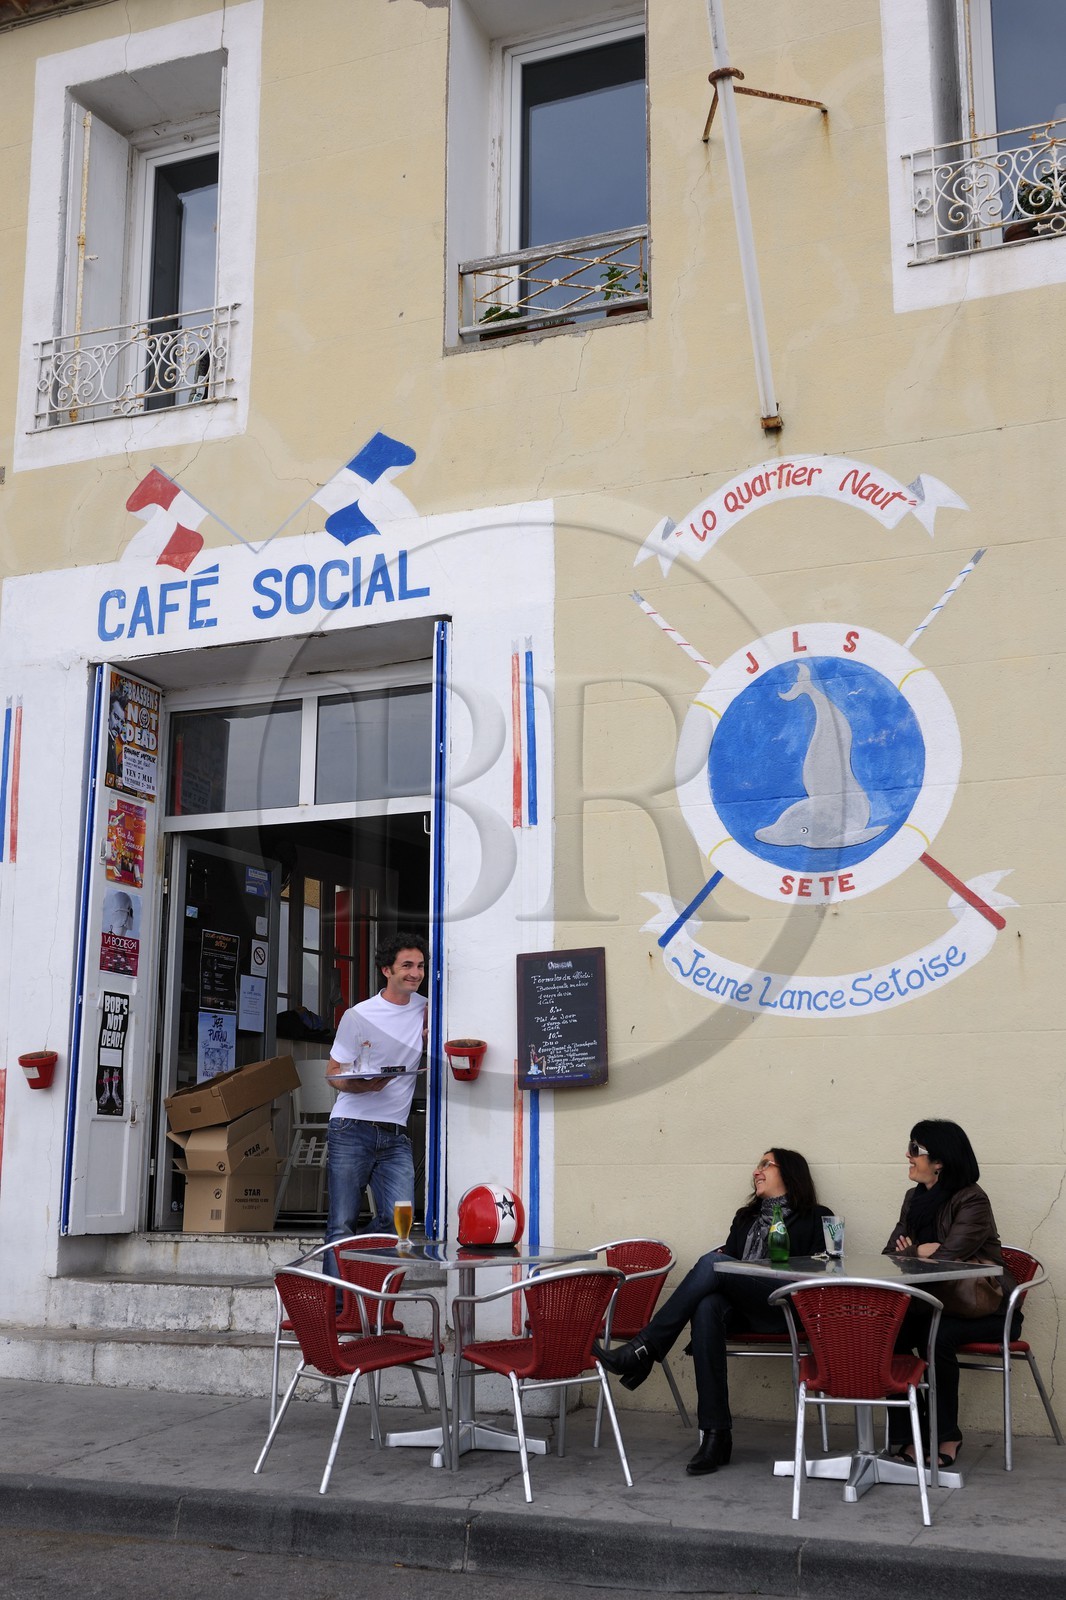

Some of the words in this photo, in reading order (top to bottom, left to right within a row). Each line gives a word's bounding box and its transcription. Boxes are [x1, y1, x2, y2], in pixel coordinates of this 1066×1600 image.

[97, 563, 220, 642] CAFÉ
[252, 549, 431, 620] SOCIAL
[127, 702, 158, 731] NOT
[122, 722, 158, 750] DEAD
[779, 872, 856, 898] SETE
[103, 935, 111, 945] LA
[111, 936, 137, 950] BODEGA
[671, 949, 753, 1003] Jeune
[758, 976, 847, 1012] Lance
[849, 945, 967, 1007] Setoise
[104, 994, 129, 1015] BOB'S
[106, 1013, 124, 1031] NOT
[101, 1029, 125, 1049] DEAD!
[244, 1143, 261, 1157] STAR
[244, 1188, 261, 1197] STAR
